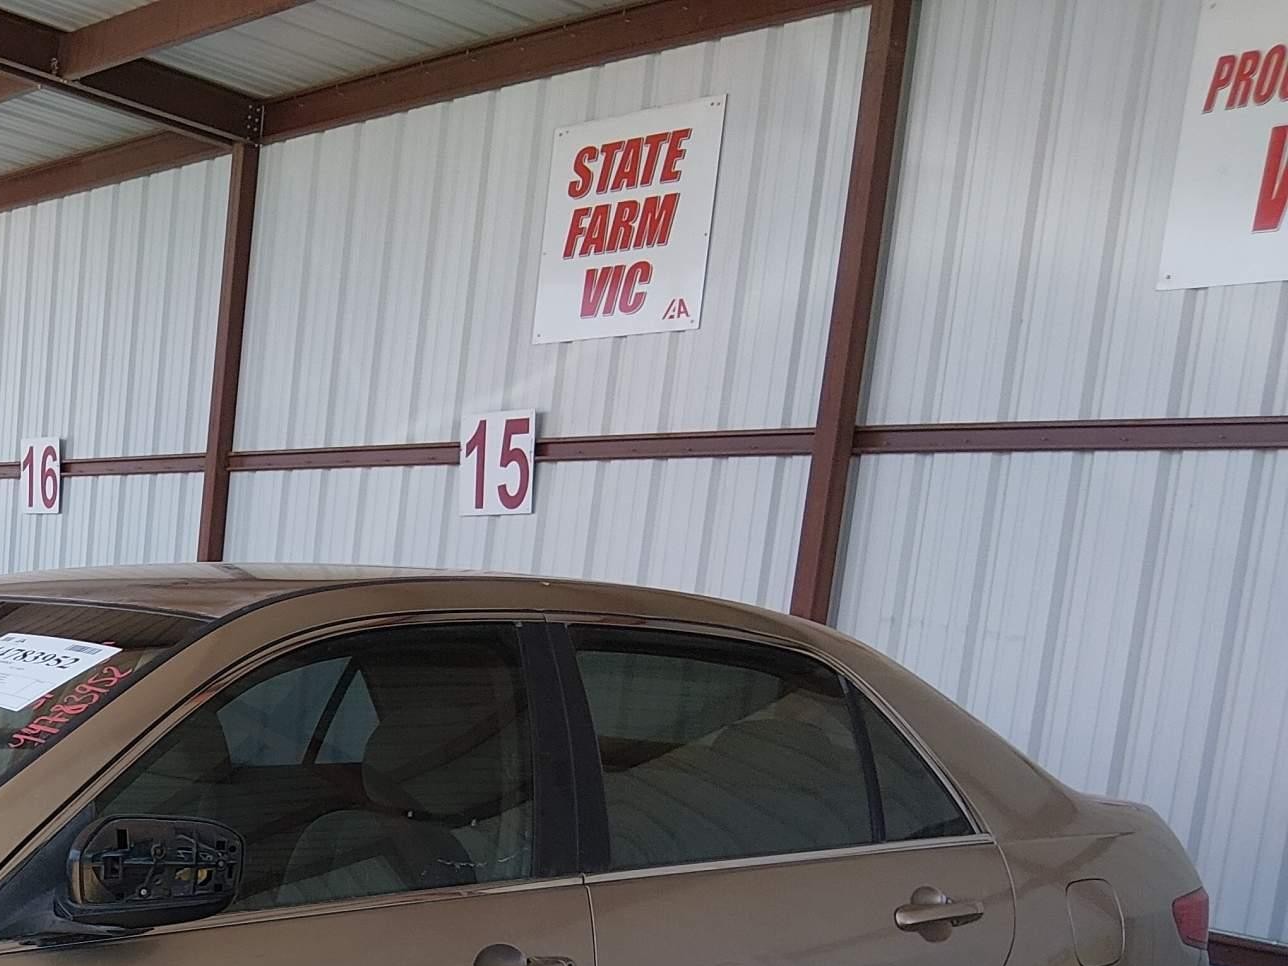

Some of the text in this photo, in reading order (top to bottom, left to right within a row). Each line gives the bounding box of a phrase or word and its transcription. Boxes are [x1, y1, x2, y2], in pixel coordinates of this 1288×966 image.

[568, 128, 693, 200] STATE
[562, 193, 680, 260] FARM
[580, 260, 653, 319] VIC
[22, 445, 58, 509] 16
[465, 417, 530, 510] 15
